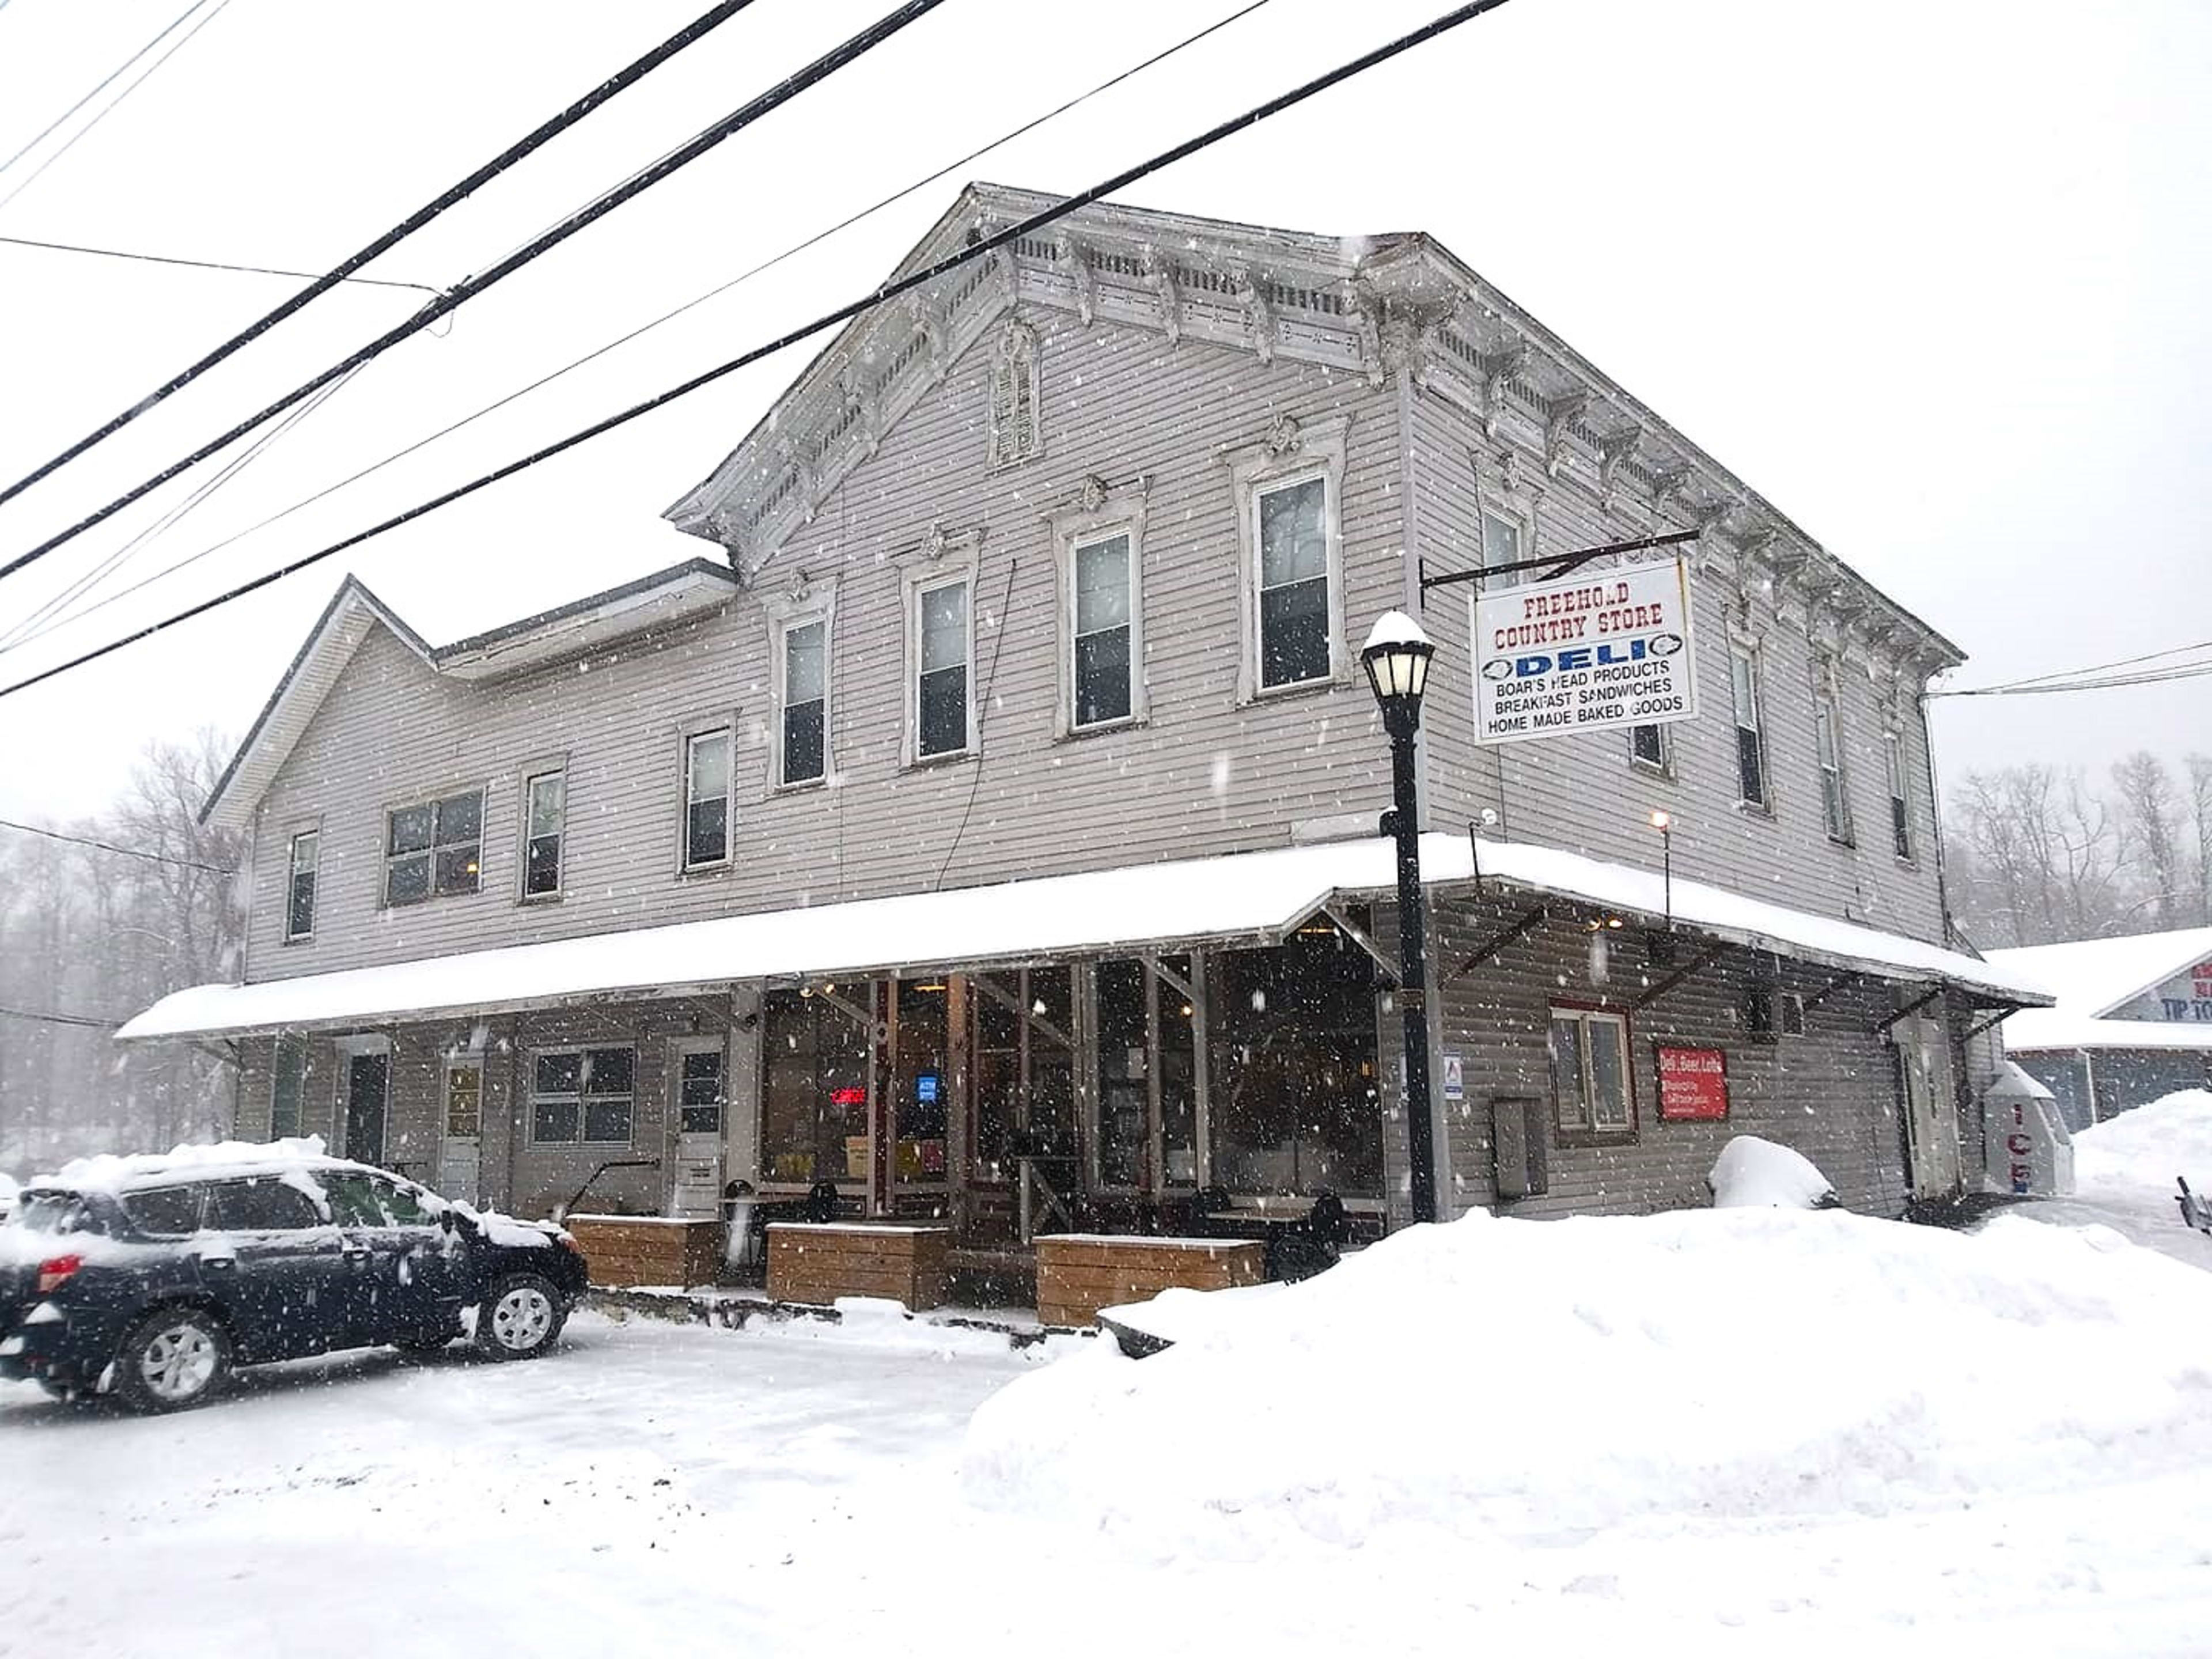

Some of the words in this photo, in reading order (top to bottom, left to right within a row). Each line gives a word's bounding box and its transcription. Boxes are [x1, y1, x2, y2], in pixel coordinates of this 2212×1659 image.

[1495, 616, 1586, 650] COUNTRY
[1599, 603, 1663, 633] STORE
[1516, 639, 1646, 677] DELI
[1495, 692, 1572, 715] BREAKFAST
[1579, 677, 1672, 704] SANDWICHES
[1497, 678, 1545, 697] BOAR'S
[1552, 672, 1587, 690] HEAD
[1594, 660, 1669, 683] PRODUCTS
[1488, 717, 1527, 733] HOME
[1533, 711, 1571, 728] MADE
[1578, 703, 1624, 722] BAKED
[1630, 696, 1683, 715] GOODS
[2161, 998, 2188, 1020] TIP
[2007, 1104, 2032, 1183] ICE
